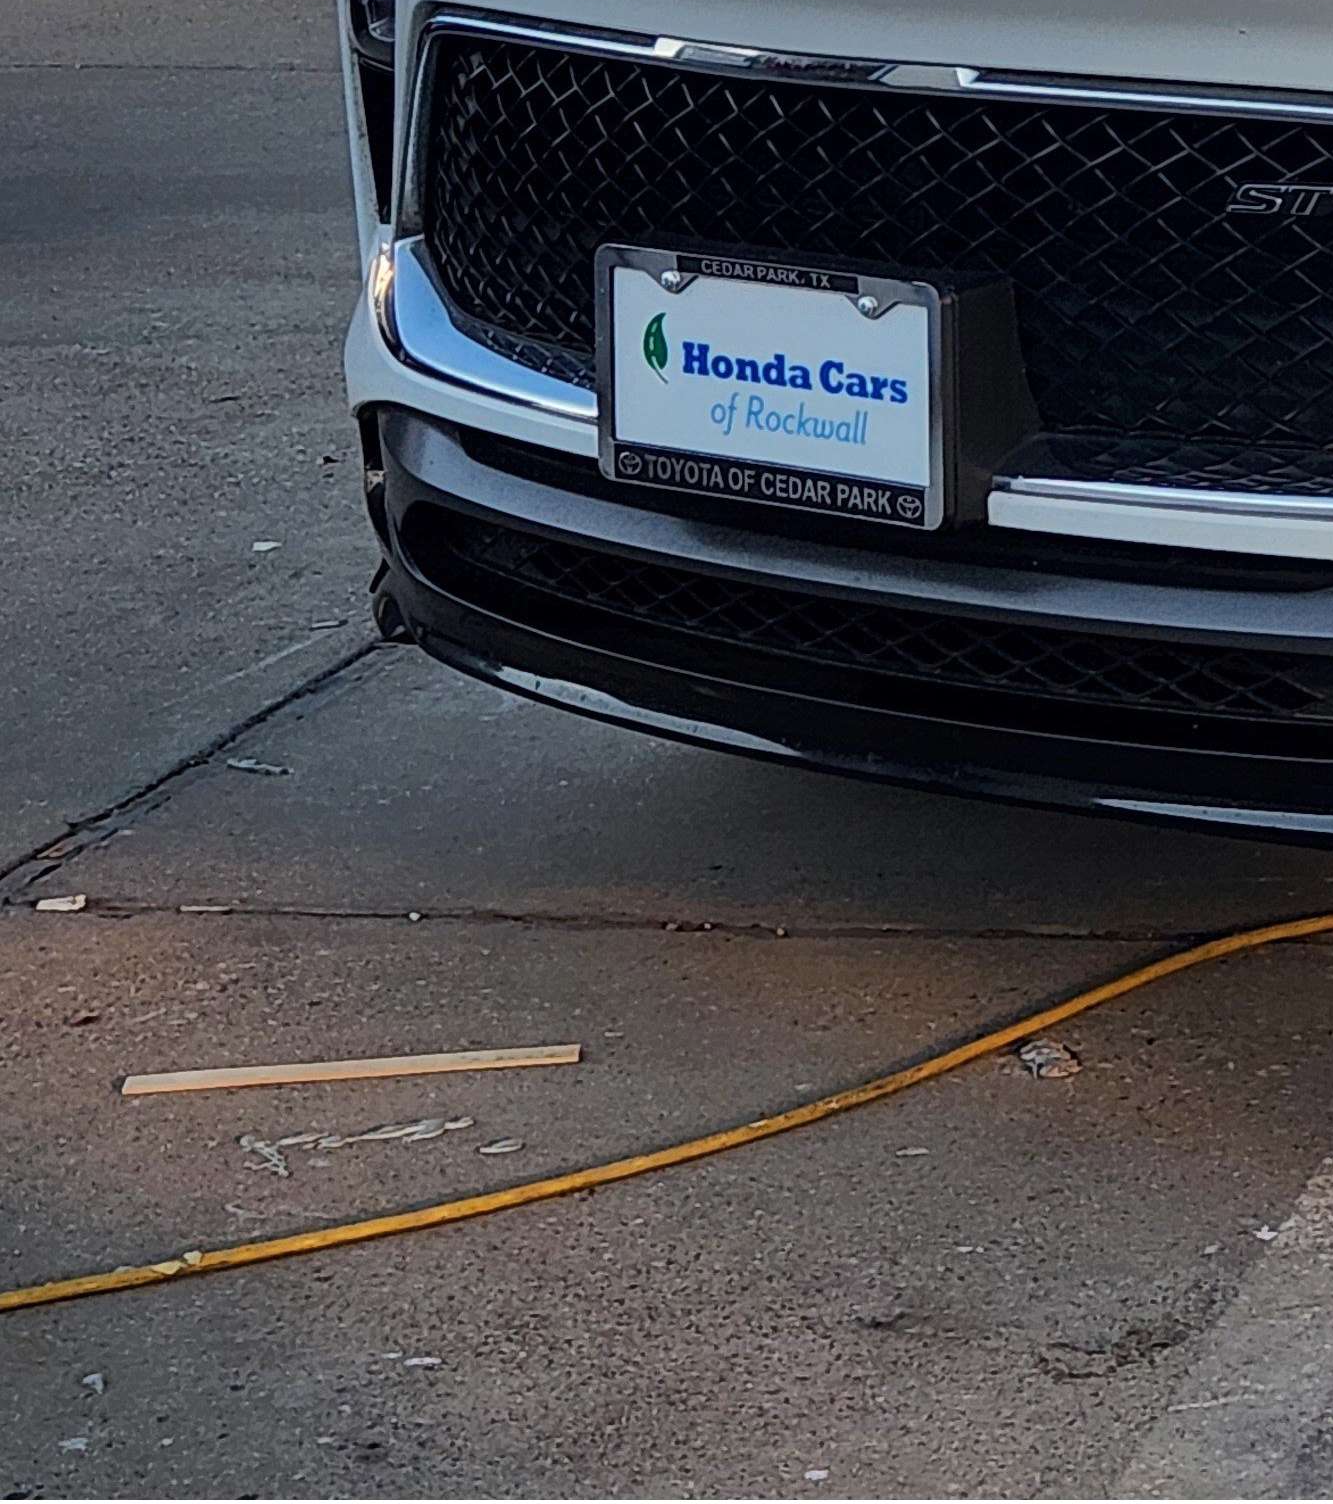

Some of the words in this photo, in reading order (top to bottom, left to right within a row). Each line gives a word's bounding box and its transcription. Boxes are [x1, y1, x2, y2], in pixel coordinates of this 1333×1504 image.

[701, 260, 753, 279] CEDAR
[810, 273, 830, 288] TX
[682, 341, 812, 390] Honda
[819, 360, 908, 404] Cars
[710, 392, 739, 436] of
[745, 395, 869, 445] Rockwall
[644, 453, 724, 489] TOYOTA
[728, 467, 755, 492] OF
[760, 472, 831, 505] CEDAR
[836, 484, 892, 515] PARK
